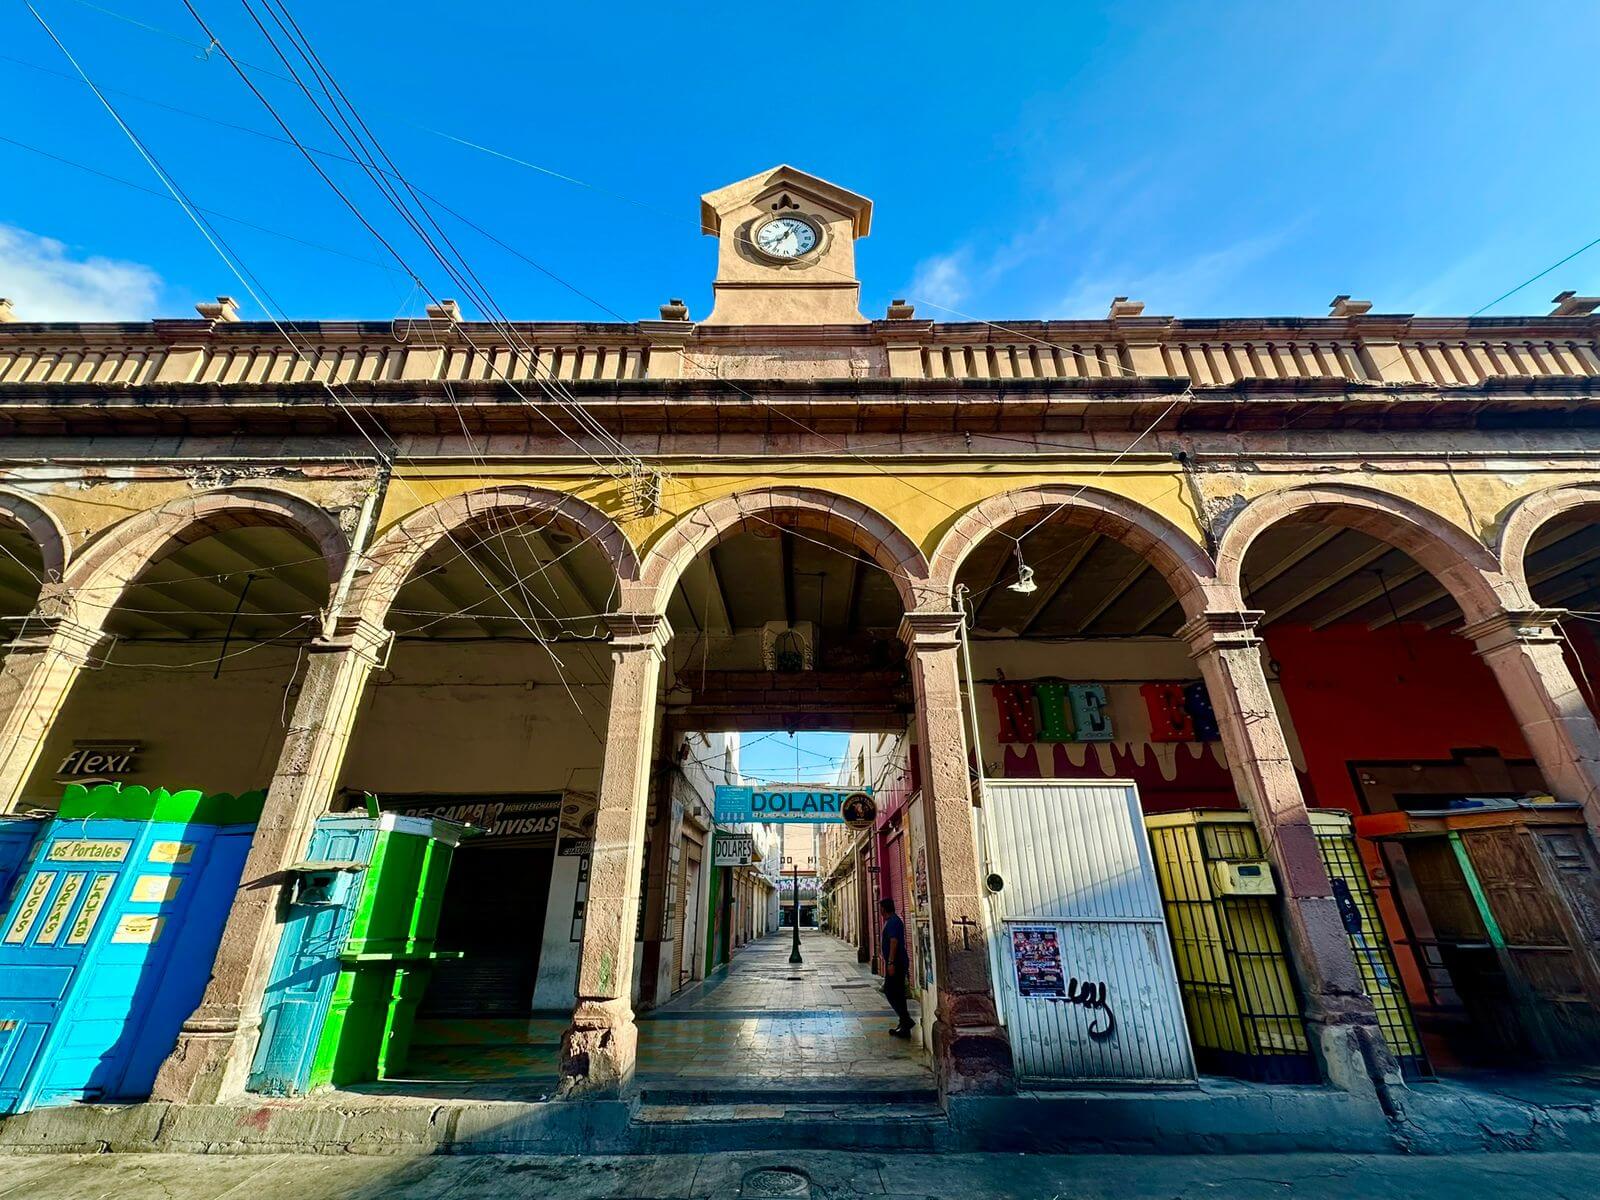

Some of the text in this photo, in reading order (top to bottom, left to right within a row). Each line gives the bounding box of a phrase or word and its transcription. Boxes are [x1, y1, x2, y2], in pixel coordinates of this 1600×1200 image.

[70, 843, 122, 858] Portales
[716, 840, 752, 857] DOLARES
[15, 873, 52, 934] JUGOS
[45, 873, 82, 935] TORTAS
[74, 874, 110, 938] FLAUTAS
